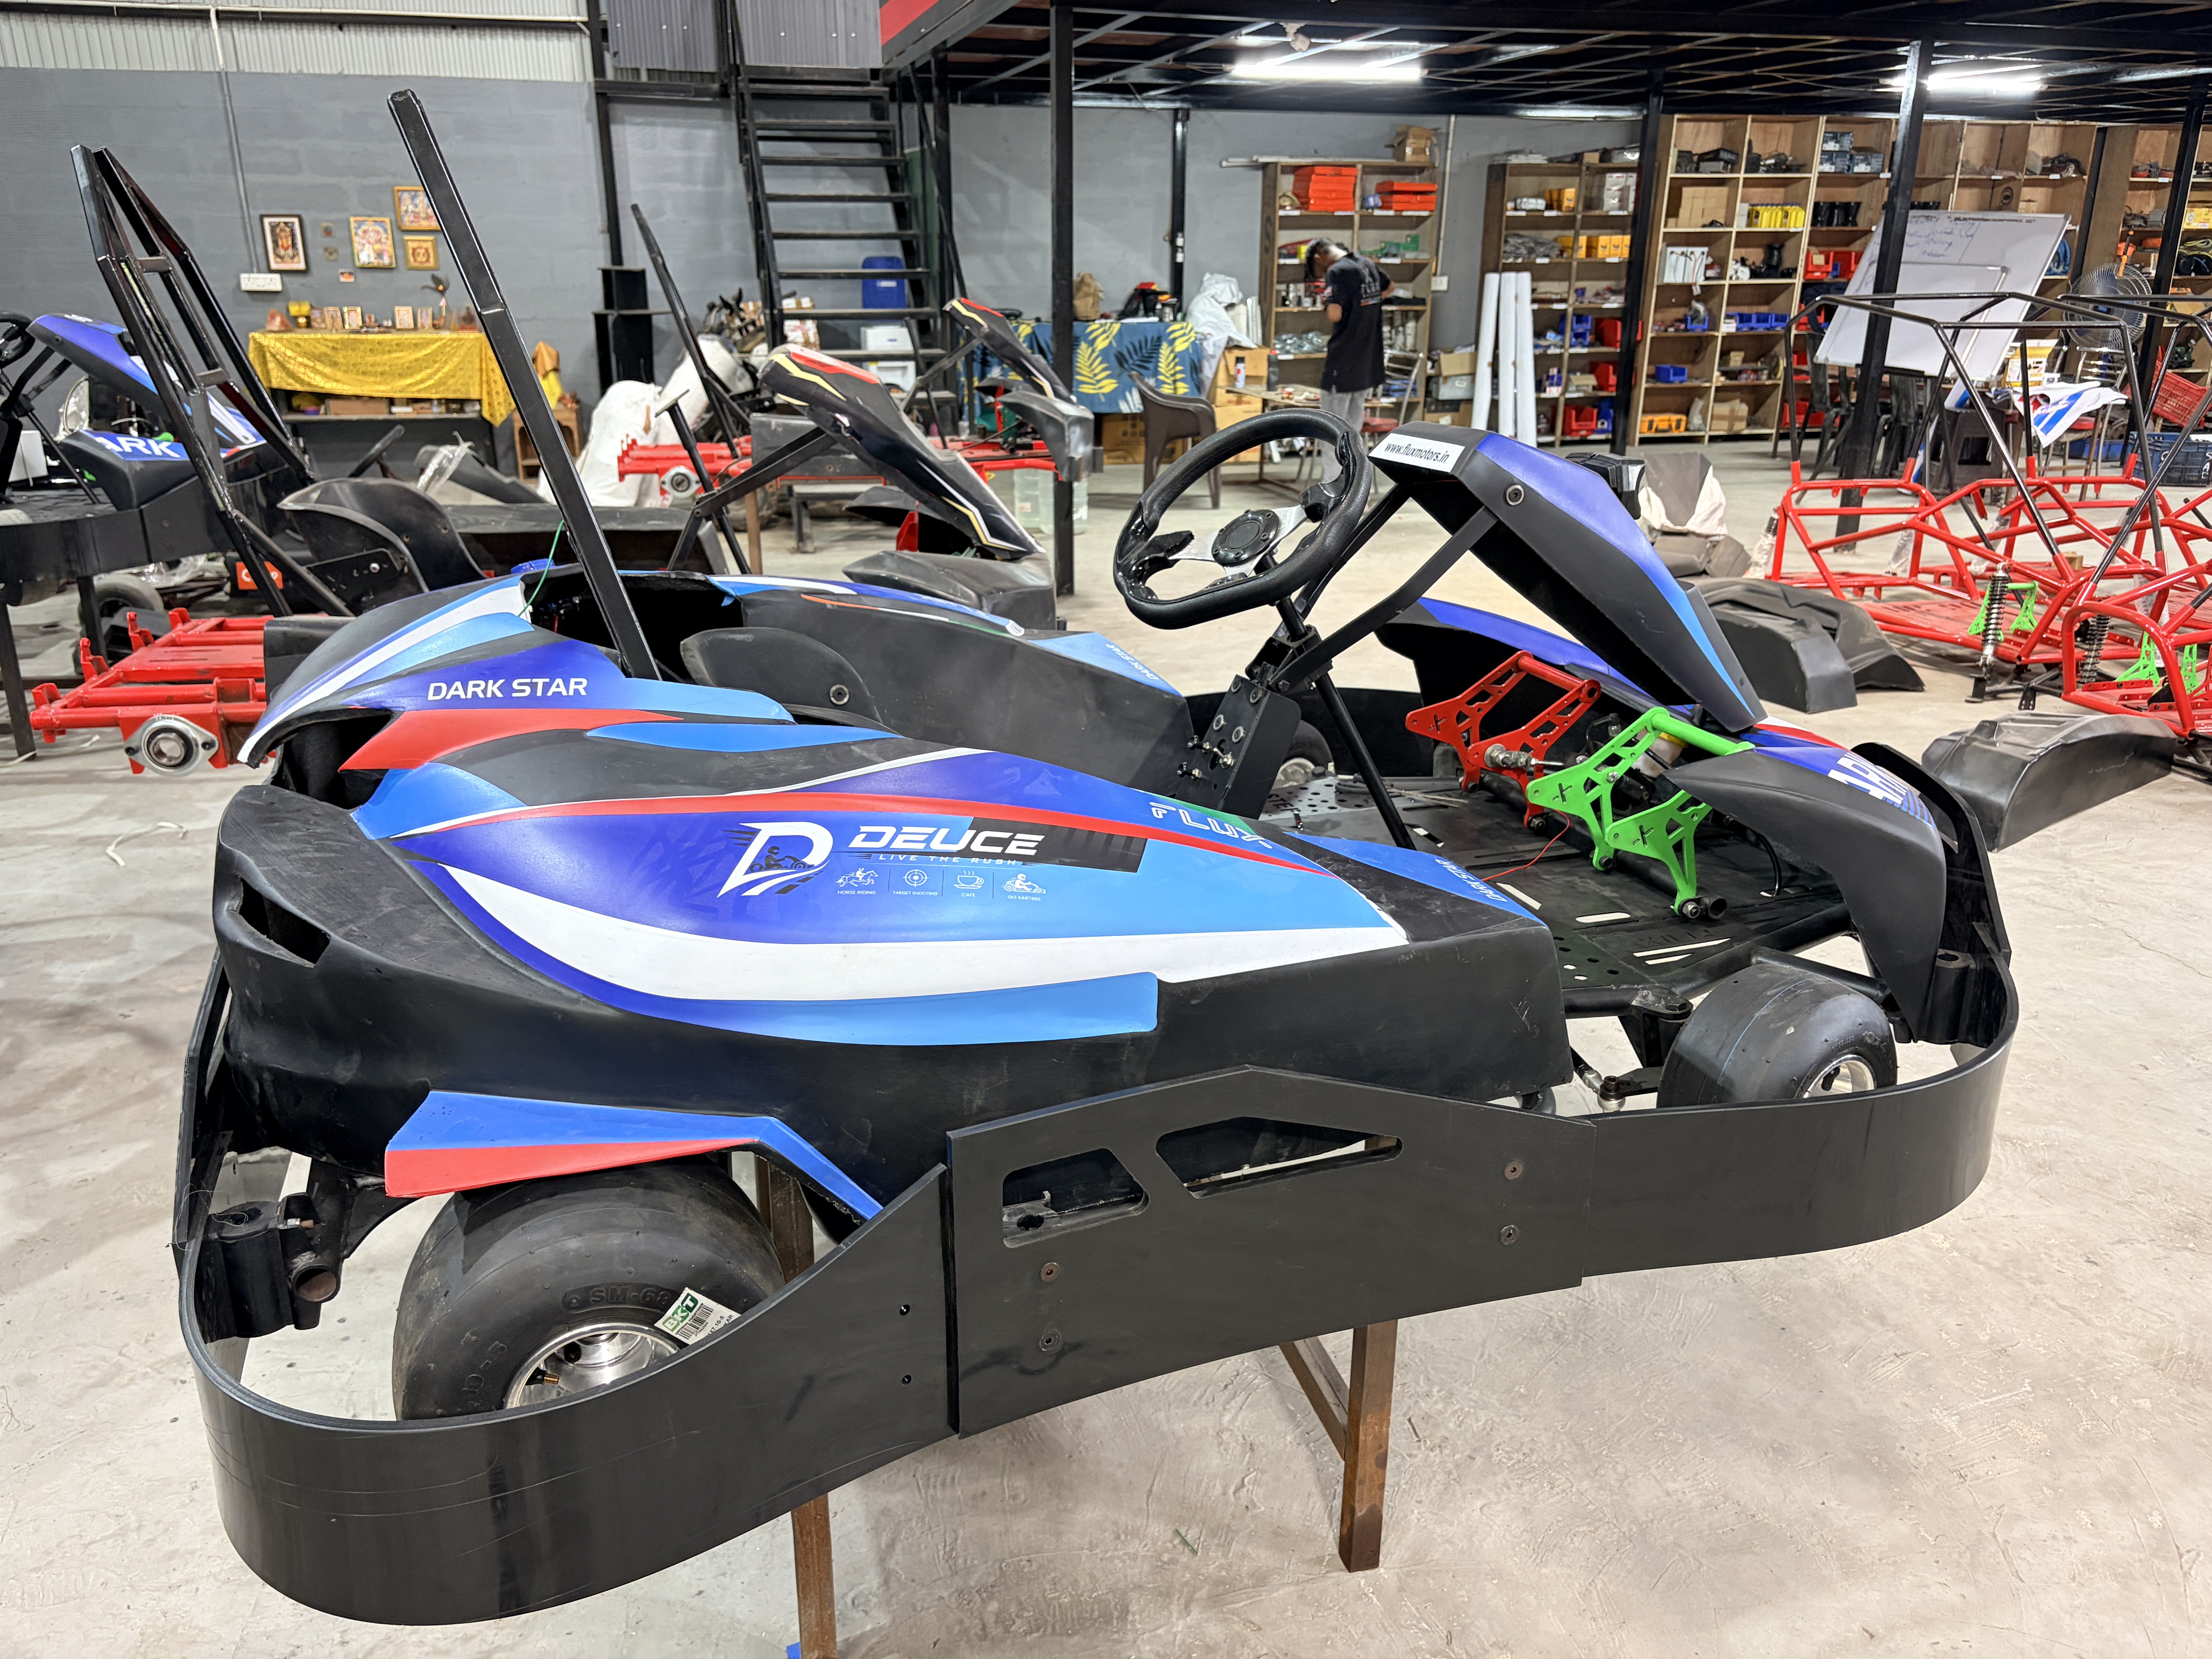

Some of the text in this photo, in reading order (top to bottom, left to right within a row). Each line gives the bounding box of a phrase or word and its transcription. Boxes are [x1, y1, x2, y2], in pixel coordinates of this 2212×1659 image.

[1384, 443, 1450, 463] www.fluxmotors.in
[1105, 644, 1159, 680] DARK STAR
[428, 678, 588, 701] DARK STAR
[1149, 802, 1273, 849] FLUX
[848, 826, 1045, 855] DEUCE
[970, 857, 1016, 866] RUSH
[1435, 859, 1508, 902] DARK STAR
[664, 1295, 695, 1330] BKT
[688, 1303, 704, 1322] TOGETHER
